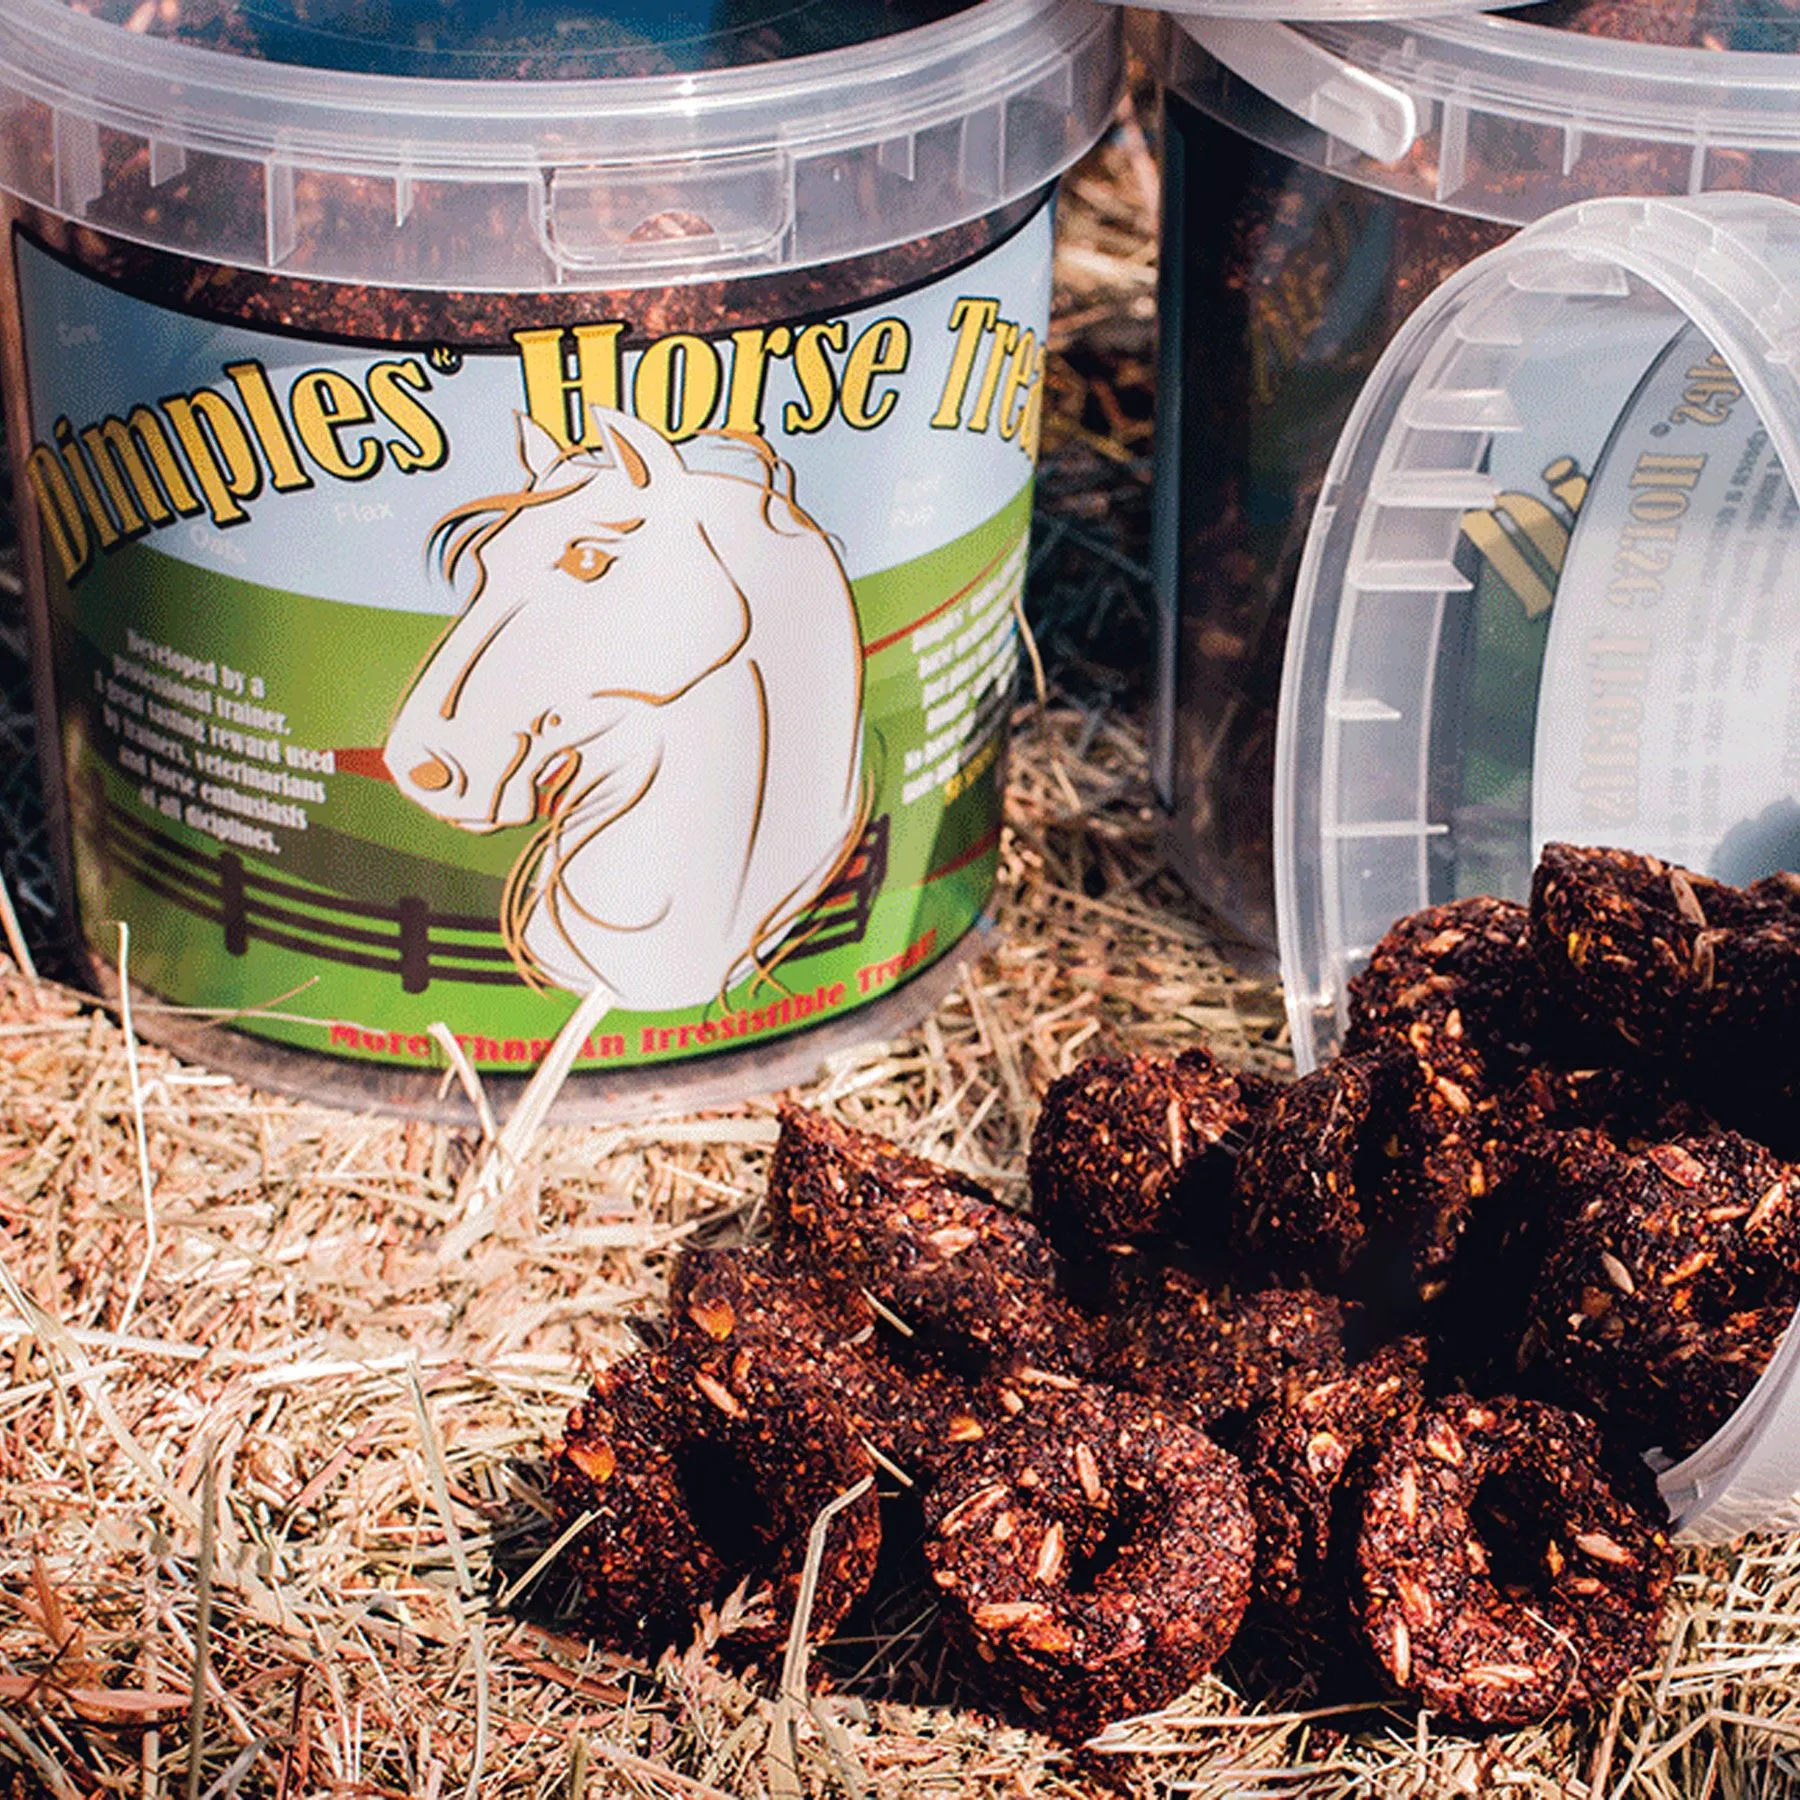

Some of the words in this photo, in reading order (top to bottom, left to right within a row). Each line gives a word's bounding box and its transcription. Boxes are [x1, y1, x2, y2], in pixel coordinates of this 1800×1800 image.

[512, 315, 911, 450] Horse
[284, 744, 336, 775] used
[329, 1020, 432, 1058] More
[640, 981, 846, 1053] Irresistible
